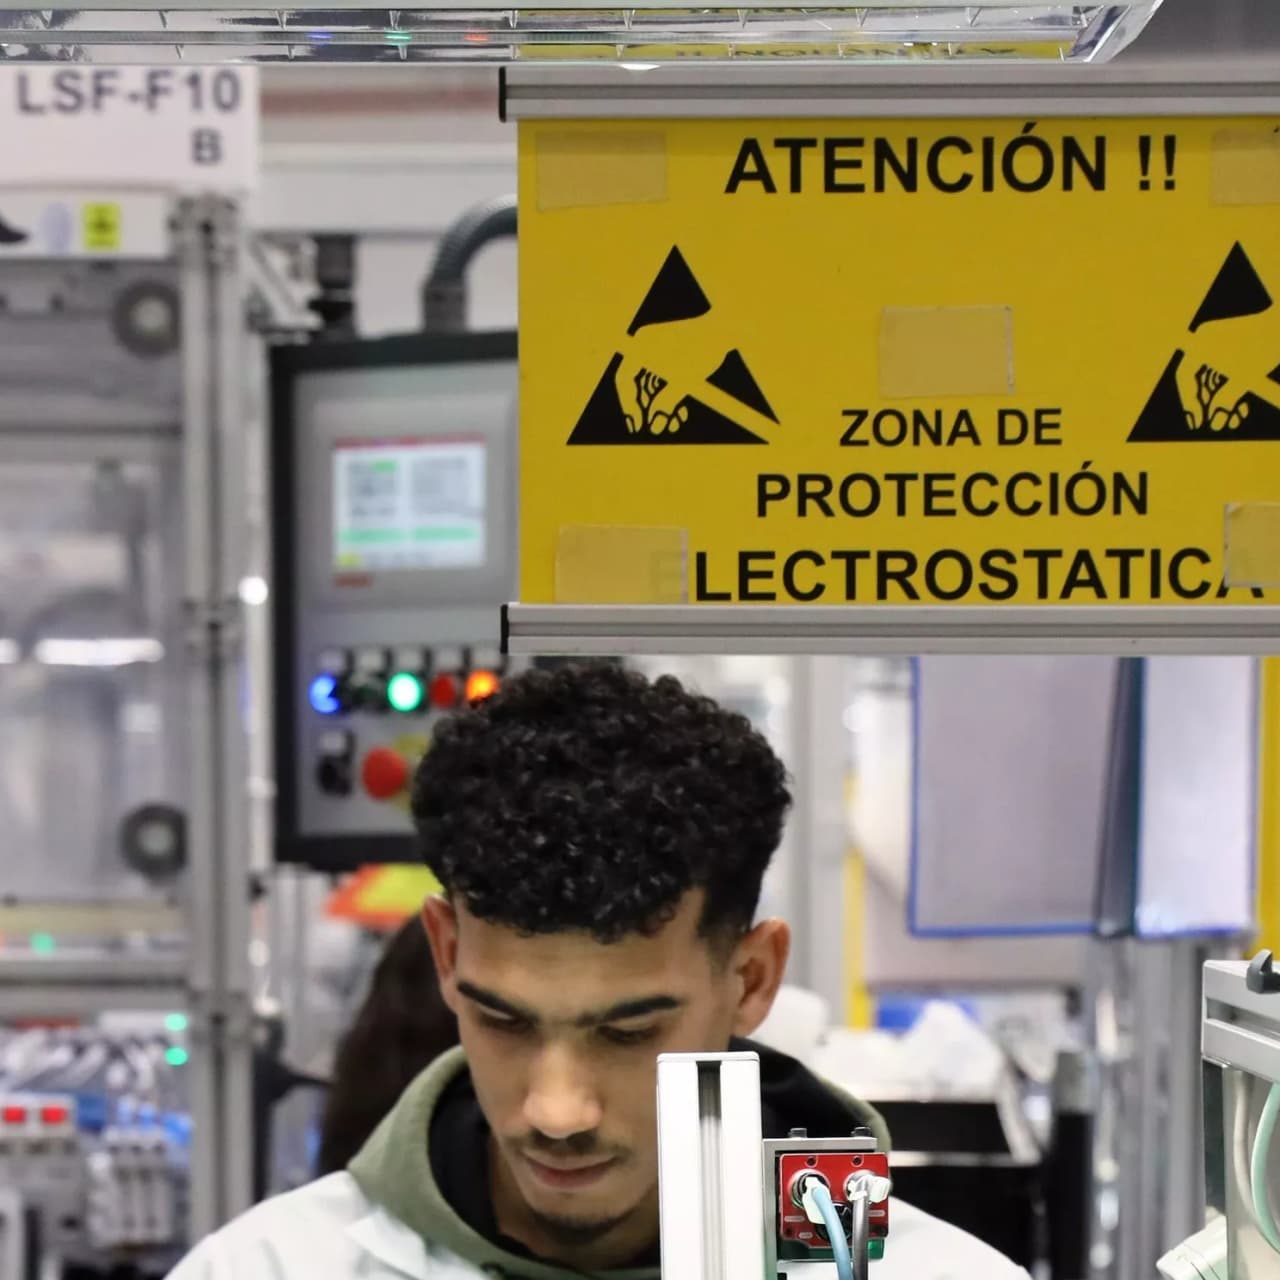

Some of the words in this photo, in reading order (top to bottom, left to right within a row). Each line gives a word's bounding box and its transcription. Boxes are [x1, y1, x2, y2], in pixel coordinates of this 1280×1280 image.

[16, 69, 242, 114] LSF-F10
[190, 128, 222, 166] B
[725, 122, 1107, 194] ATENCIÓN
[1138, 134, 1177, 191] !!
[839, 408, 981, 447] ZONA
[997, 408, 1062, 446] DE
[757, 461, 1148, 518] PROTECCIÓN
[651, 548, 1264, 602] LECTROSTATIC
